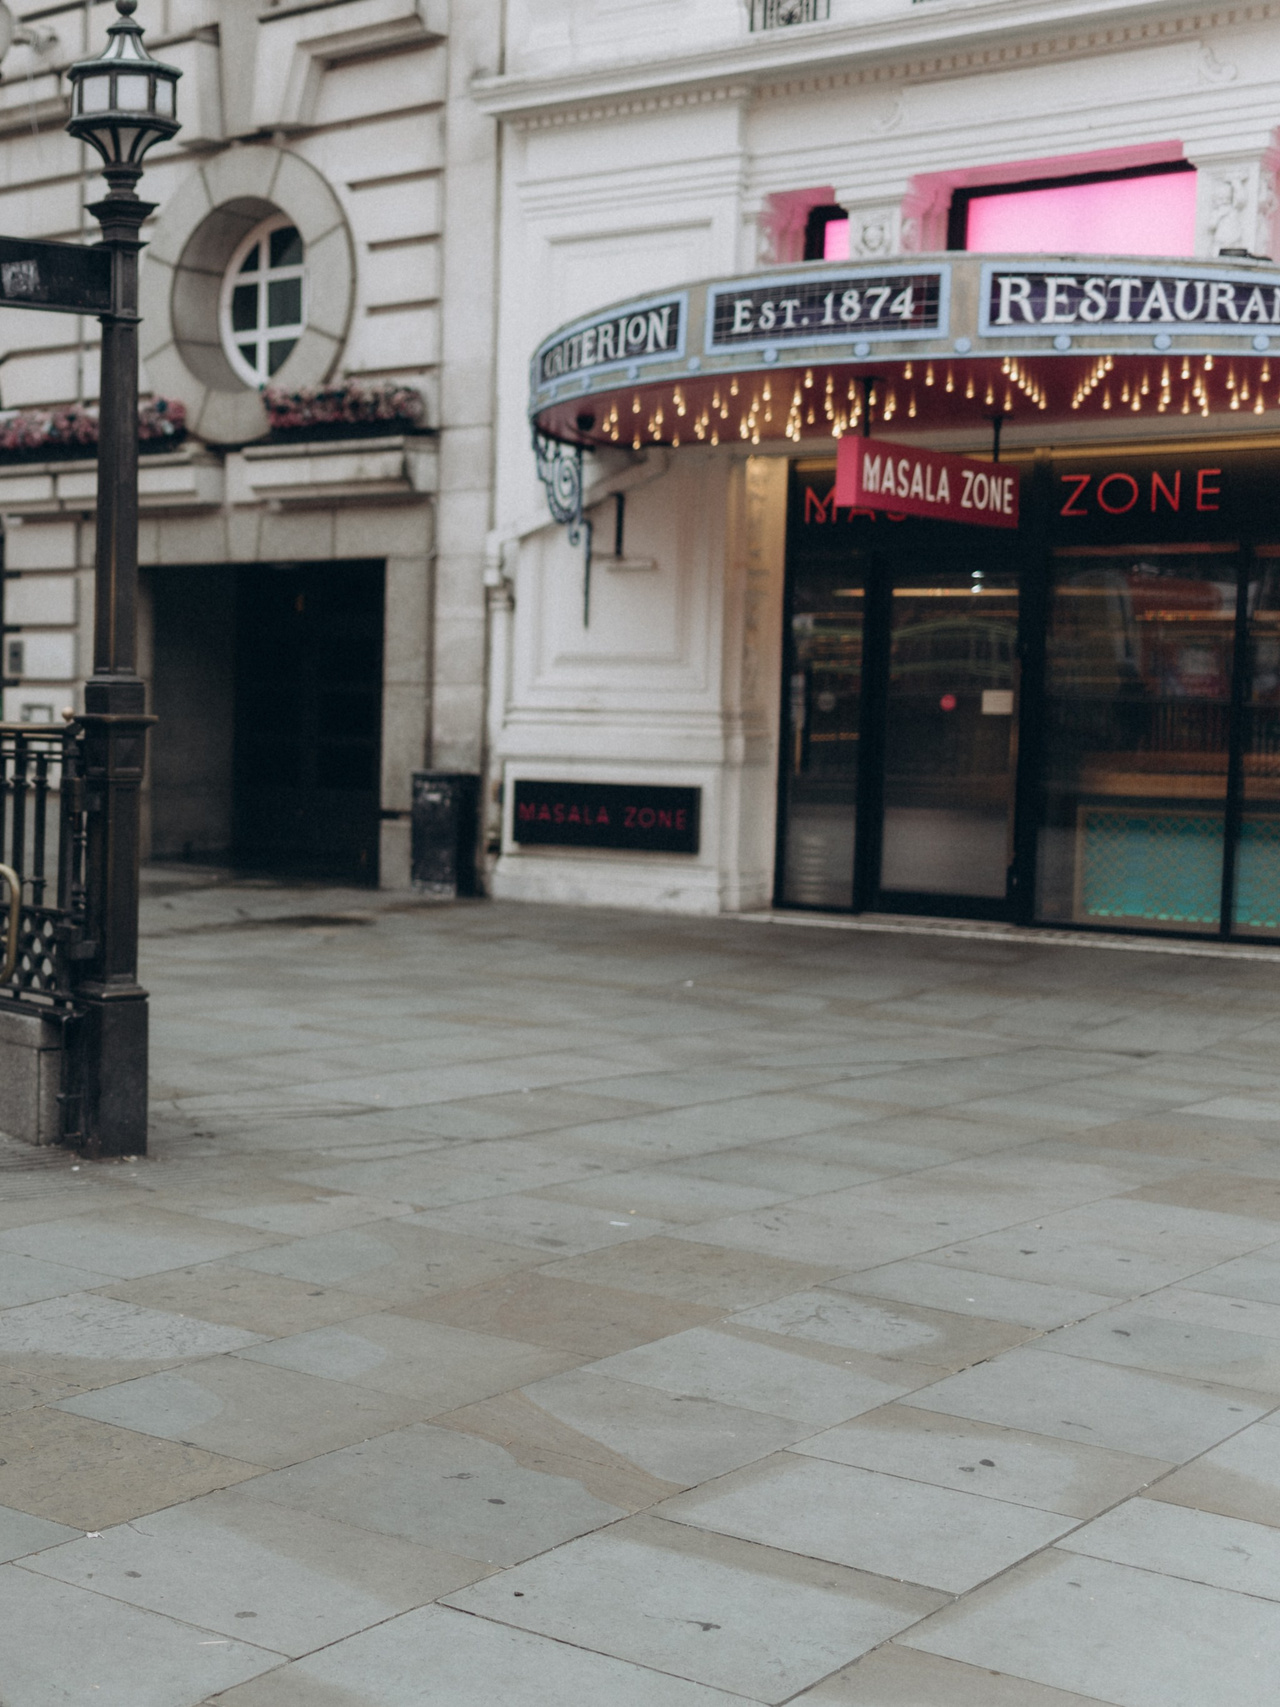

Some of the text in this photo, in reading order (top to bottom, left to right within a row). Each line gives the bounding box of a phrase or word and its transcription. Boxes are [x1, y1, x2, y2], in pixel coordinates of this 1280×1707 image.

[730, 285, 916, 334] EST. 1874
[993, 276, 1280, 325] RESTAURA
[544, 306, 672, 378] CRITERION
[862, 451, 951, 505] MASALA
[960, 469, 1014, 515] ZONE
[1060, 468, 1222, 516] ZONE
[519, 802, 687, 831] MASALA ZONE
